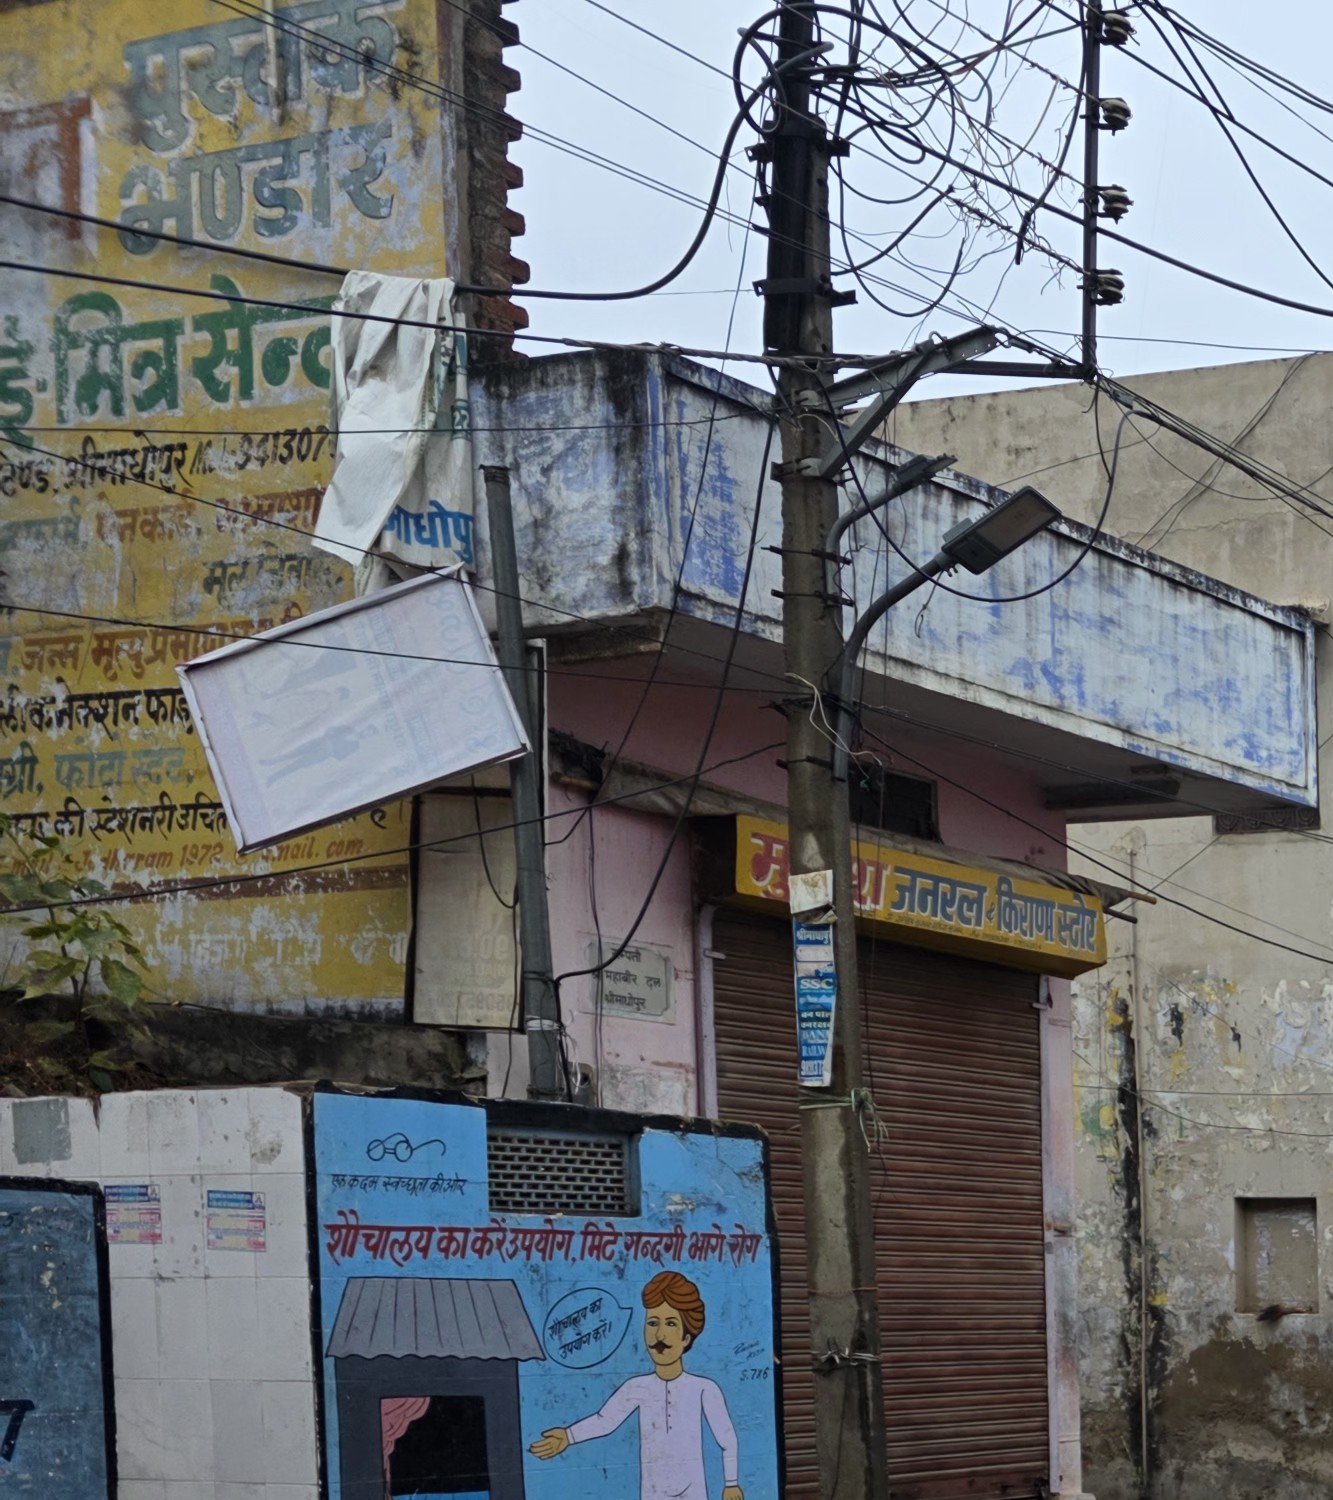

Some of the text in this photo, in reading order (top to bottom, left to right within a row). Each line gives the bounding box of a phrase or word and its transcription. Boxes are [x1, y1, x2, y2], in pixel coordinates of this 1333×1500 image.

[122, 0, 397, 153] पुस्तक
[118, 120, 395, 256] भण्डार
[890, 866, 988, 930] जनरल
[800, 978, 835, 990] SSC
[437, 1226, 472, 1261] का
[579, 1220, 623, 1262] मिटे
[624, 1223, 687, 1269] गन्दगी
[688, 1222, 727, 1263] भागे
[728, 1222, 764, 1269] रोग
